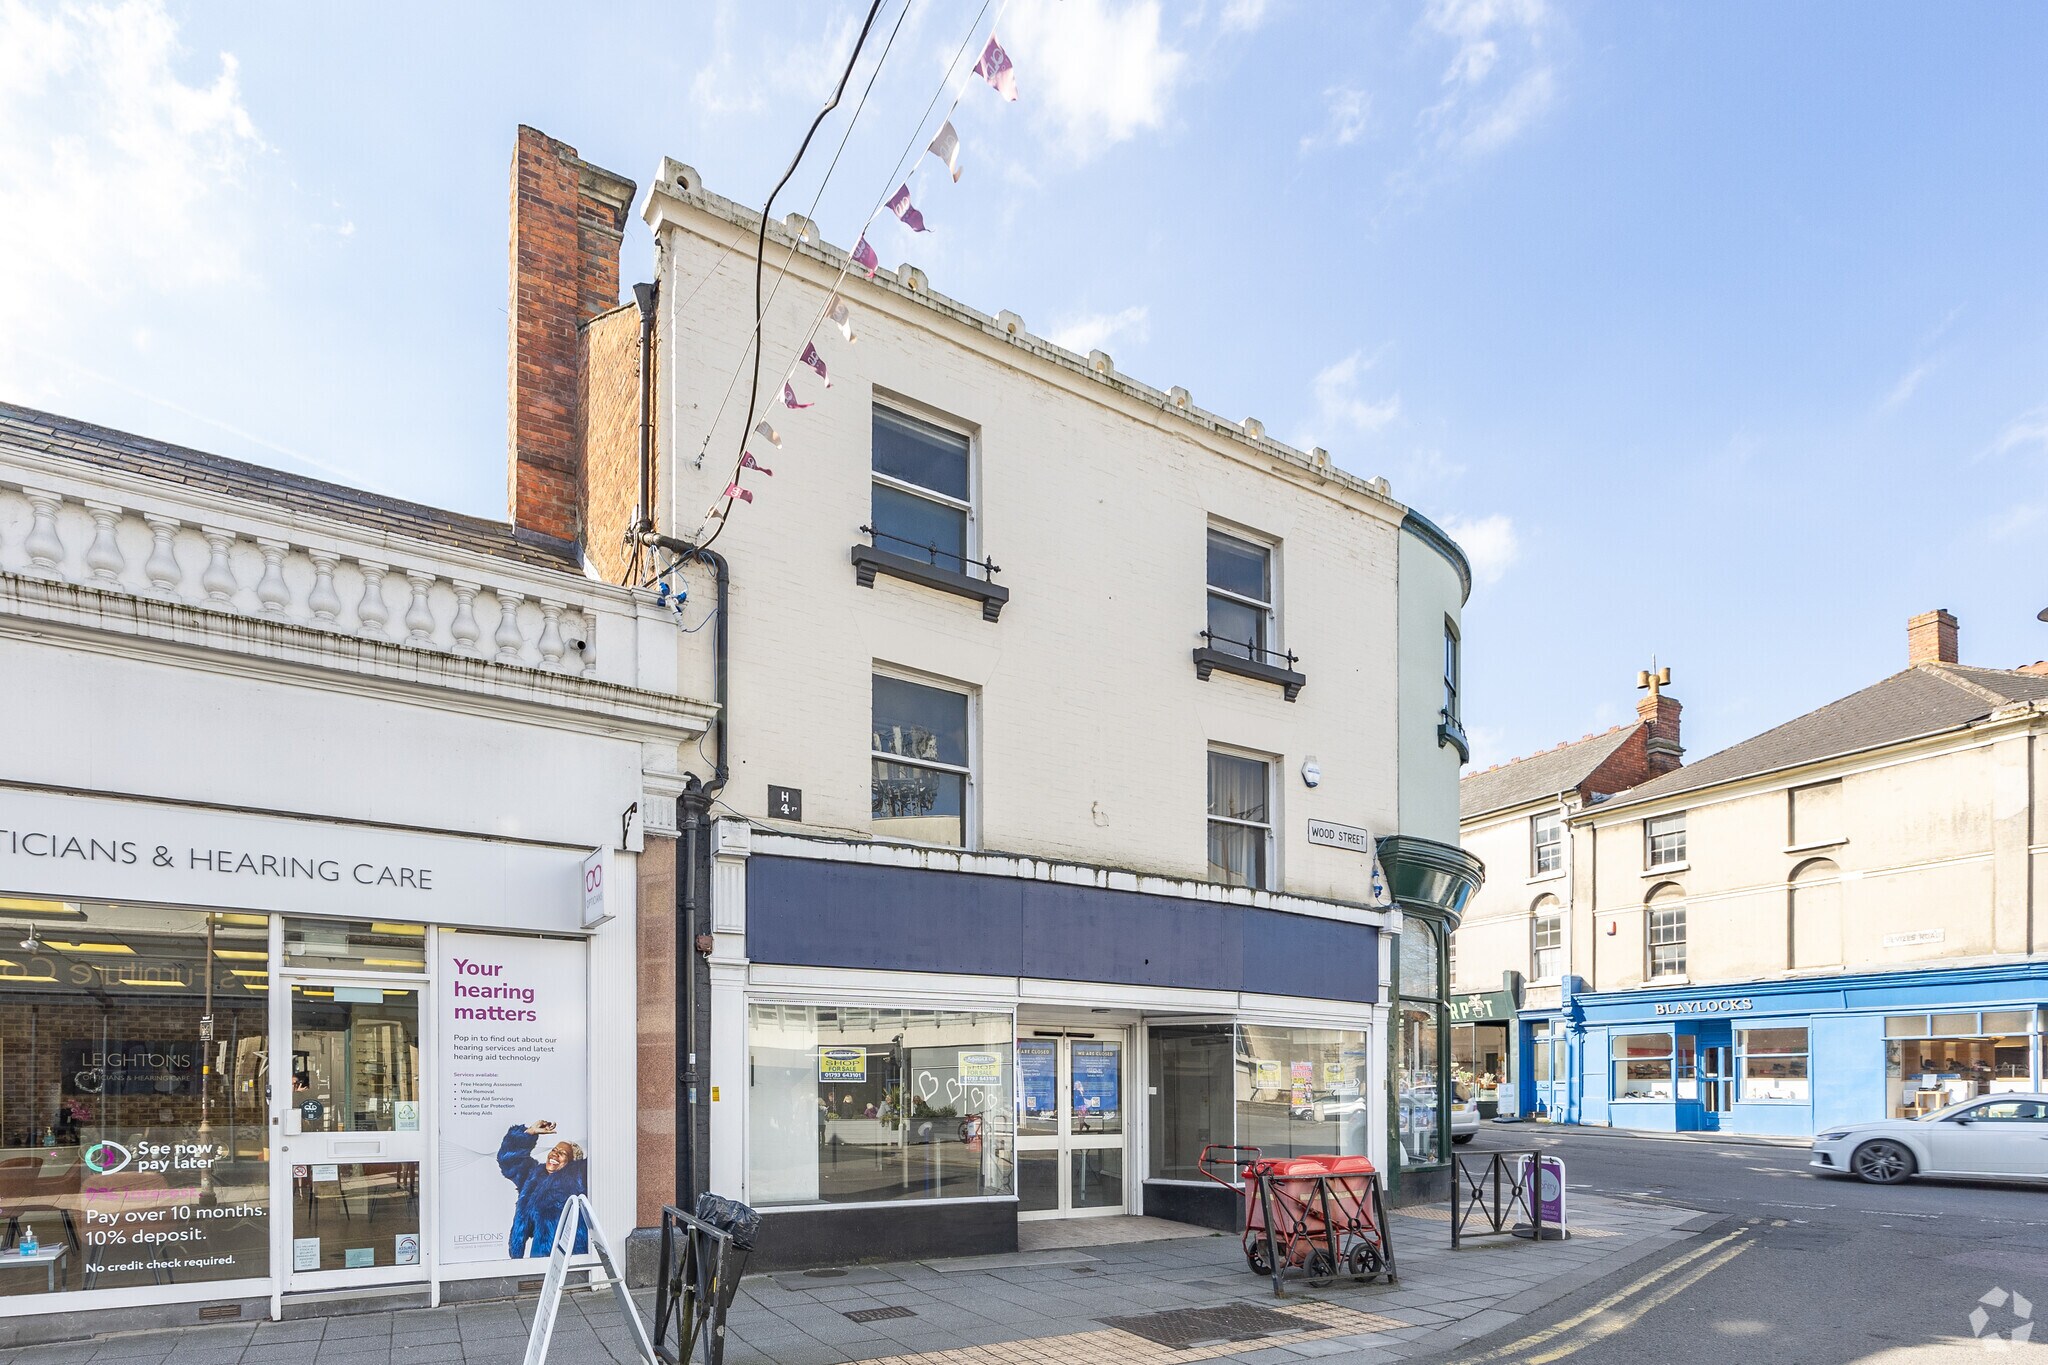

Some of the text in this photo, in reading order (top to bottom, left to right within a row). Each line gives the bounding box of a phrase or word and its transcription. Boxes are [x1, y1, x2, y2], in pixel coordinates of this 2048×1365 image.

[781, 790, 789, 802] H
[780, 803, 790, 815] 4
[1311, 826, 1365, 845] WOOD STREET
[152, 844, 175, 868] &
[190, 848, 340, 882] HEARING
[353, 863, 433, 890] CARE
[452, 957, 504, 977] Your
[454, 980, 535, 1004] hearing
[454, 1005, 537, 1022] matters
[1655, 997, 1754, 1016] BLAYLOCKS
[453, 1034, 470, 1042] Pop
[453, 1044, 483, 1052] hearing
[533, 1045, 555, 1053] latest
[82, 1052, 191, 1068] LEIGHTONS
[453, 1053, 484, 1062] hearing
[499, 1054, 541, 1062] technology
[138, 1141, 213, 1155] See now
[138, 1156, 215, 1173] pay later
[86, 1203, 267, 1226] Pay over 10 months.
[85, 1227, 207, 1246] 10% deposit.
[453, 1232, 504, 1243] LEIGHTONS
[85, 1255, 236, 1273] No credit check required.
